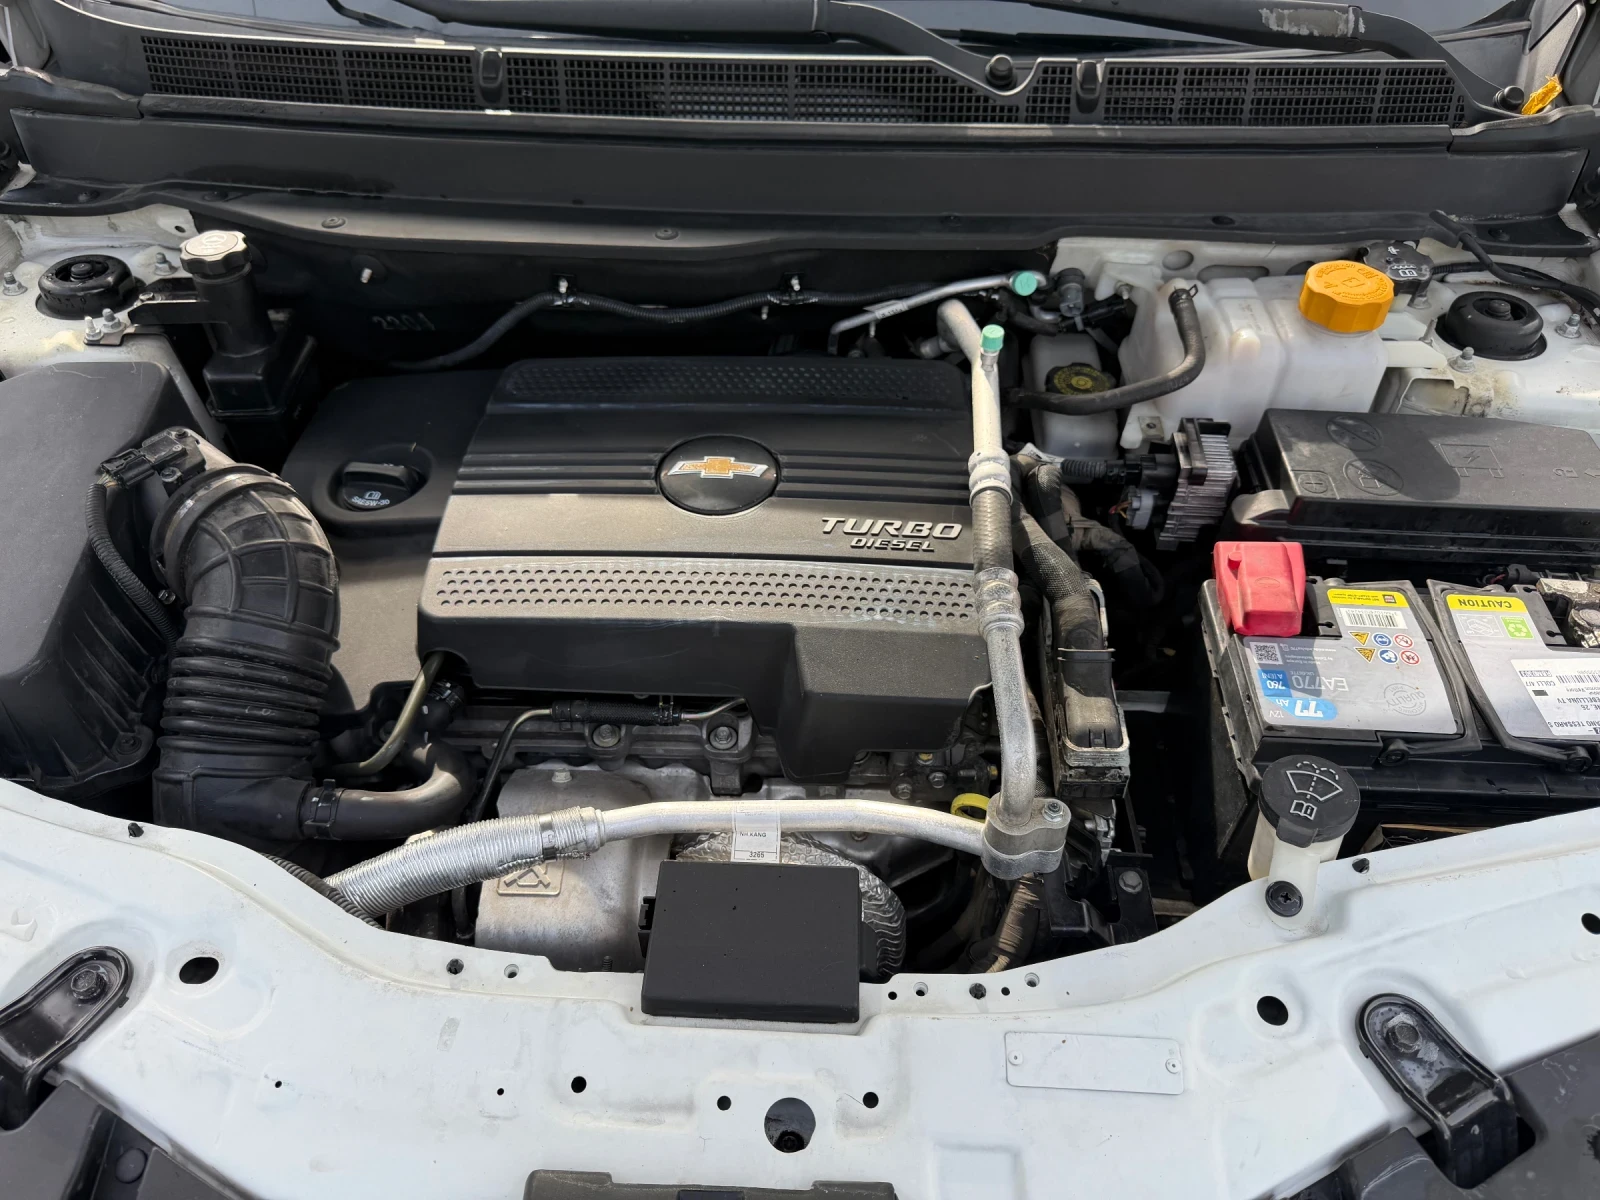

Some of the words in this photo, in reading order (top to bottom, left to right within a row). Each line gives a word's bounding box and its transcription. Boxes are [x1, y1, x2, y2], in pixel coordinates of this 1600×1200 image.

[821, 516, 963, 540] TURBO
[850, 537, 935, 553] DIESEL
[1457, 599, 1512, 608] CAUTION
[1266, 680, 1286, 690] 760
[1292, 676, 1349, 692] EA770
[1276, 698, 1289, 706] Ah
[1386, 690, 1426, 708] QUALITY
[1269, 710, 1284, 718] 12V
[1294, 700, 1324, 718] 77
[748, 850, 765, 858] 3265
